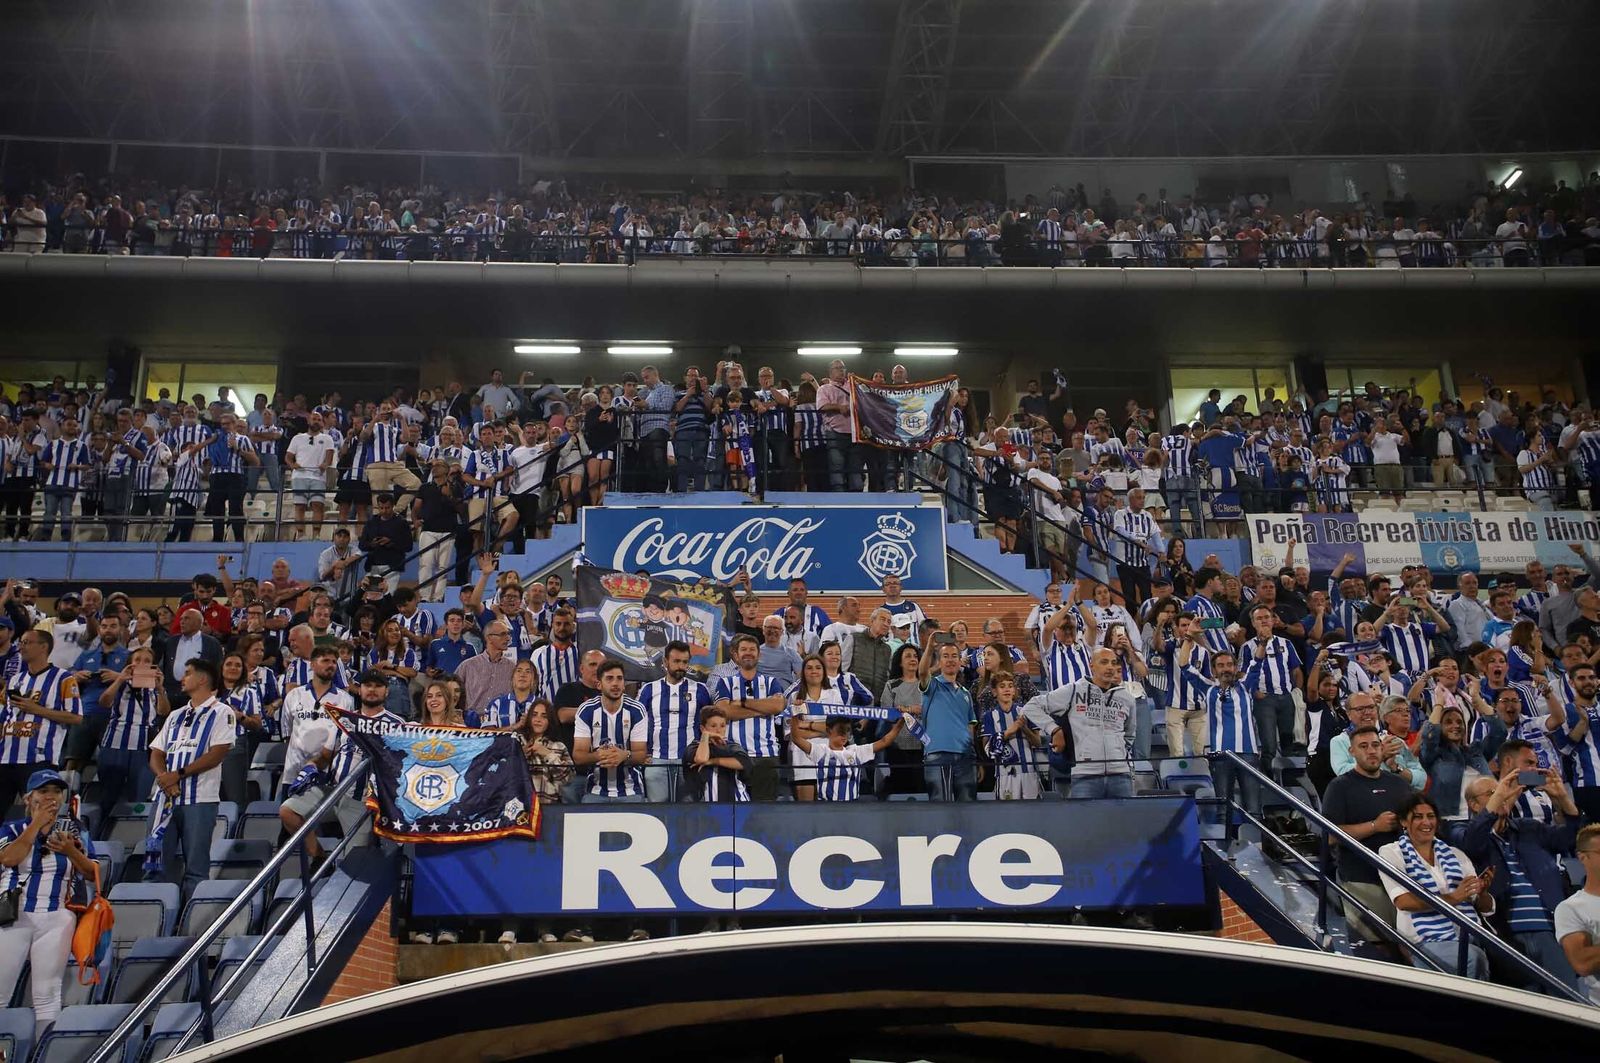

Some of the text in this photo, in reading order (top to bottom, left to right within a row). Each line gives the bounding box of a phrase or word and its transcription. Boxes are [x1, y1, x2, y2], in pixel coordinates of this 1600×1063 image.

[1255, 517, 1318, 544] Peña
[1321, 516, 1502, 544] Recreativista
[1507, 516, 1539, 543] de
[612, 516, 827, 582] Coca-Cola
[822, 705, 889, 719] RECREATIVO
[357, 717, 438, 740] RECREATIVO
[463, 818, 501, 832] 2007
[561, 812, 1064, 910] Recre
